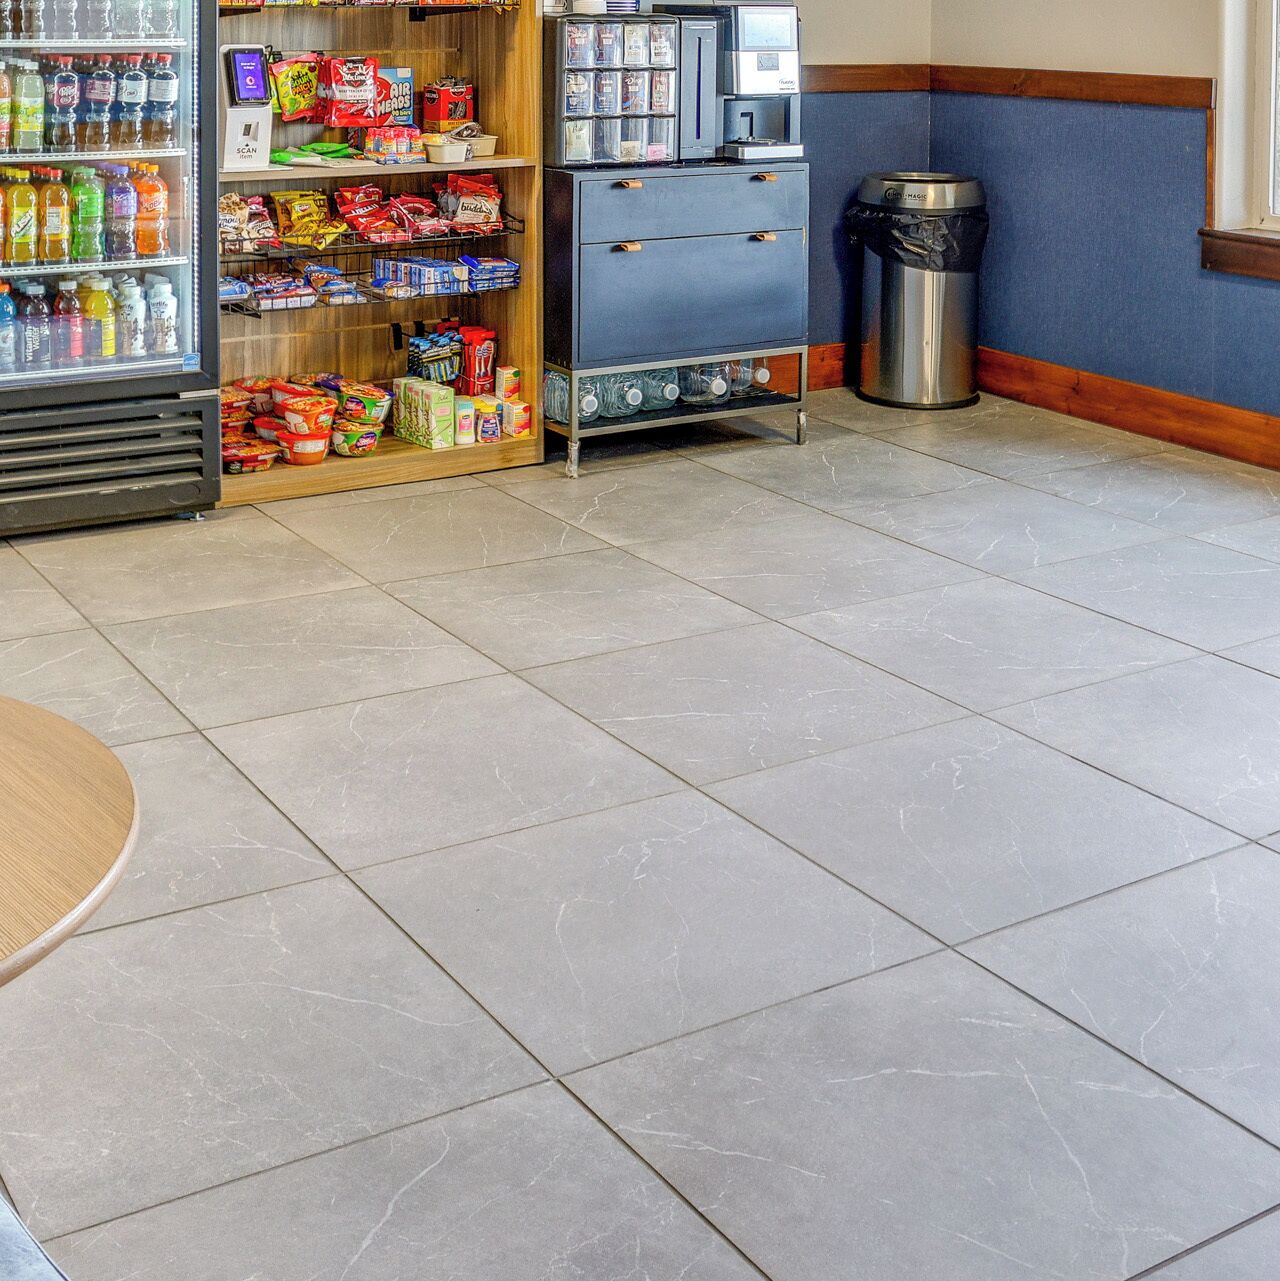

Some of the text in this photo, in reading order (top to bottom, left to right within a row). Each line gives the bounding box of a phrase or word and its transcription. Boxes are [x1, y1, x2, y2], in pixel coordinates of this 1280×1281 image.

[292, 81, 313, 95] PATCH
[390, 82, 411, 96] AIR
[377, 95, 411, 117] HEADS
[24, 326, 33, 361] vitamin
